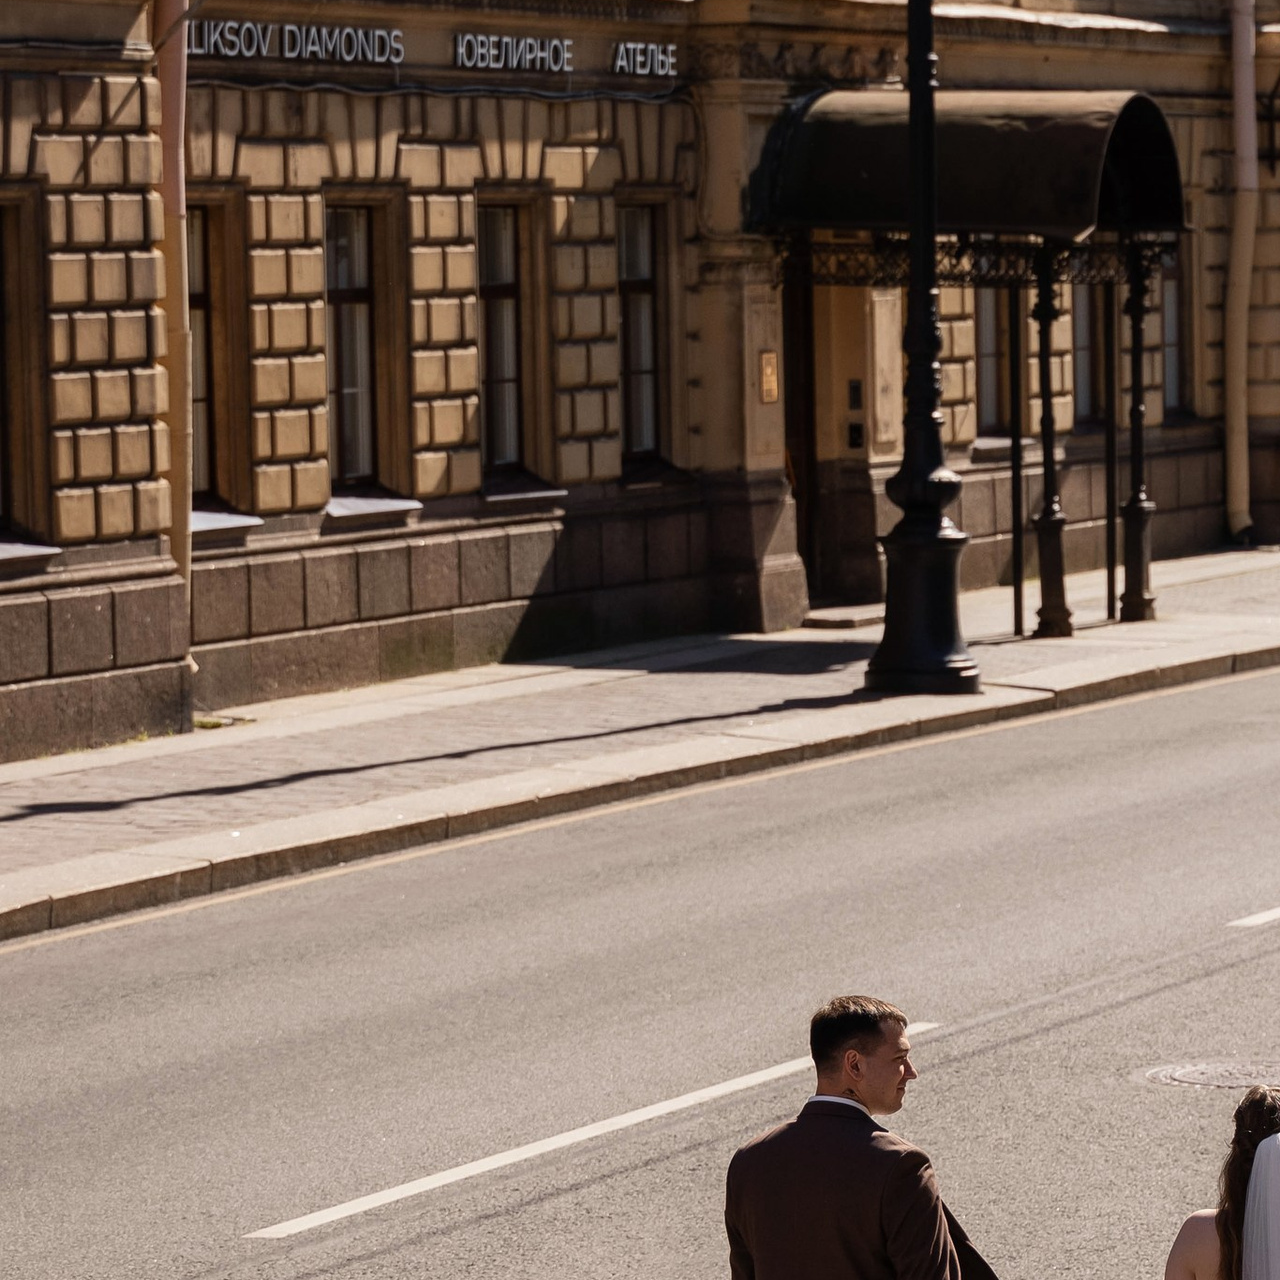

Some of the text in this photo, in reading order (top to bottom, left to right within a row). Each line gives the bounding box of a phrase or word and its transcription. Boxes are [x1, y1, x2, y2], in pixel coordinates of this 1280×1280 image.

[187, 20, 404, 63] LIKSOV DIAMONDS
[457, 33, 677, 76] ЮВЕЛИРНОЕ АТЕЛЬЕ
